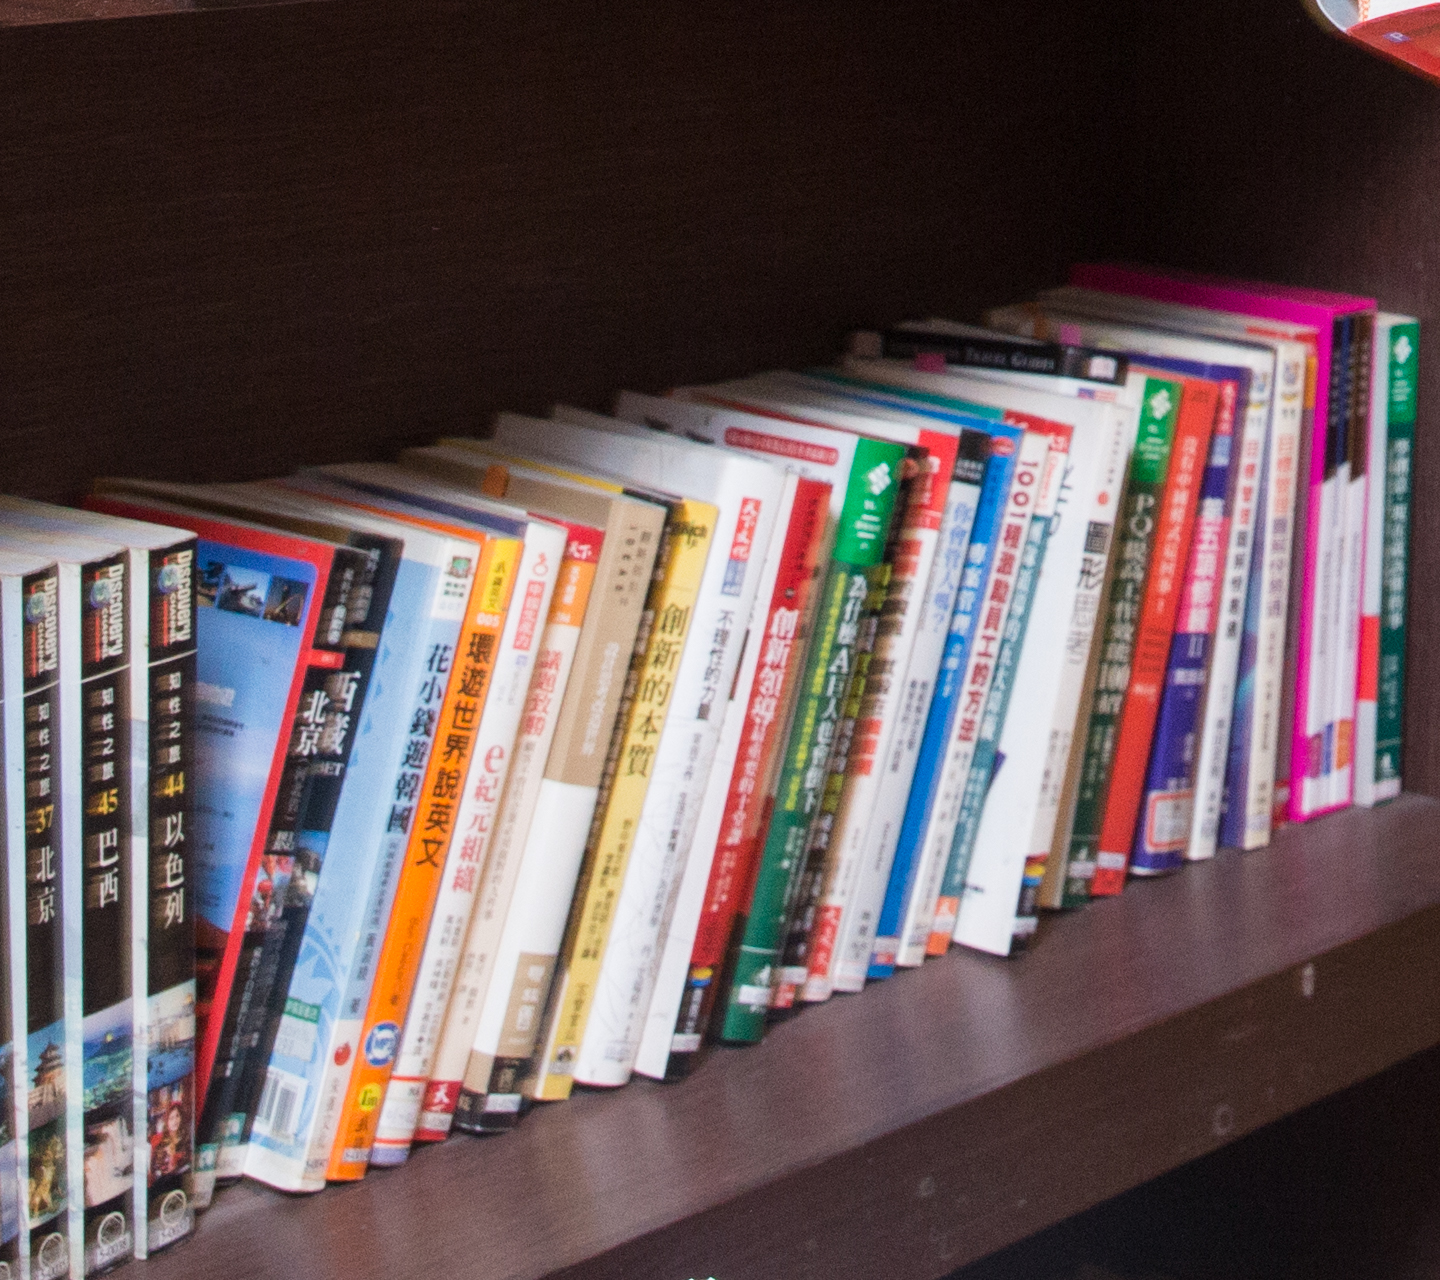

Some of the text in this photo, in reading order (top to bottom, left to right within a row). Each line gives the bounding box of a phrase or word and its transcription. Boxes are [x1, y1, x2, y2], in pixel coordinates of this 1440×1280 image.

[101, 689, 115, 781] 知性之旅
[168, 671, 182, 765] 知性之旅
[625, 602, 692, 777] 創新的本質
[163, 771, 184, 796] 44
[386, 642, 453, 835] 花小錢遊韓國
[415, 632, 497, 869] 環遊世界說英文
[97, 789, 119, 815] 45
[36, 845, 57, 925] 北京
[98, 830, 120, 909] 巴西
[163, 812, 185, 931] 以色列
